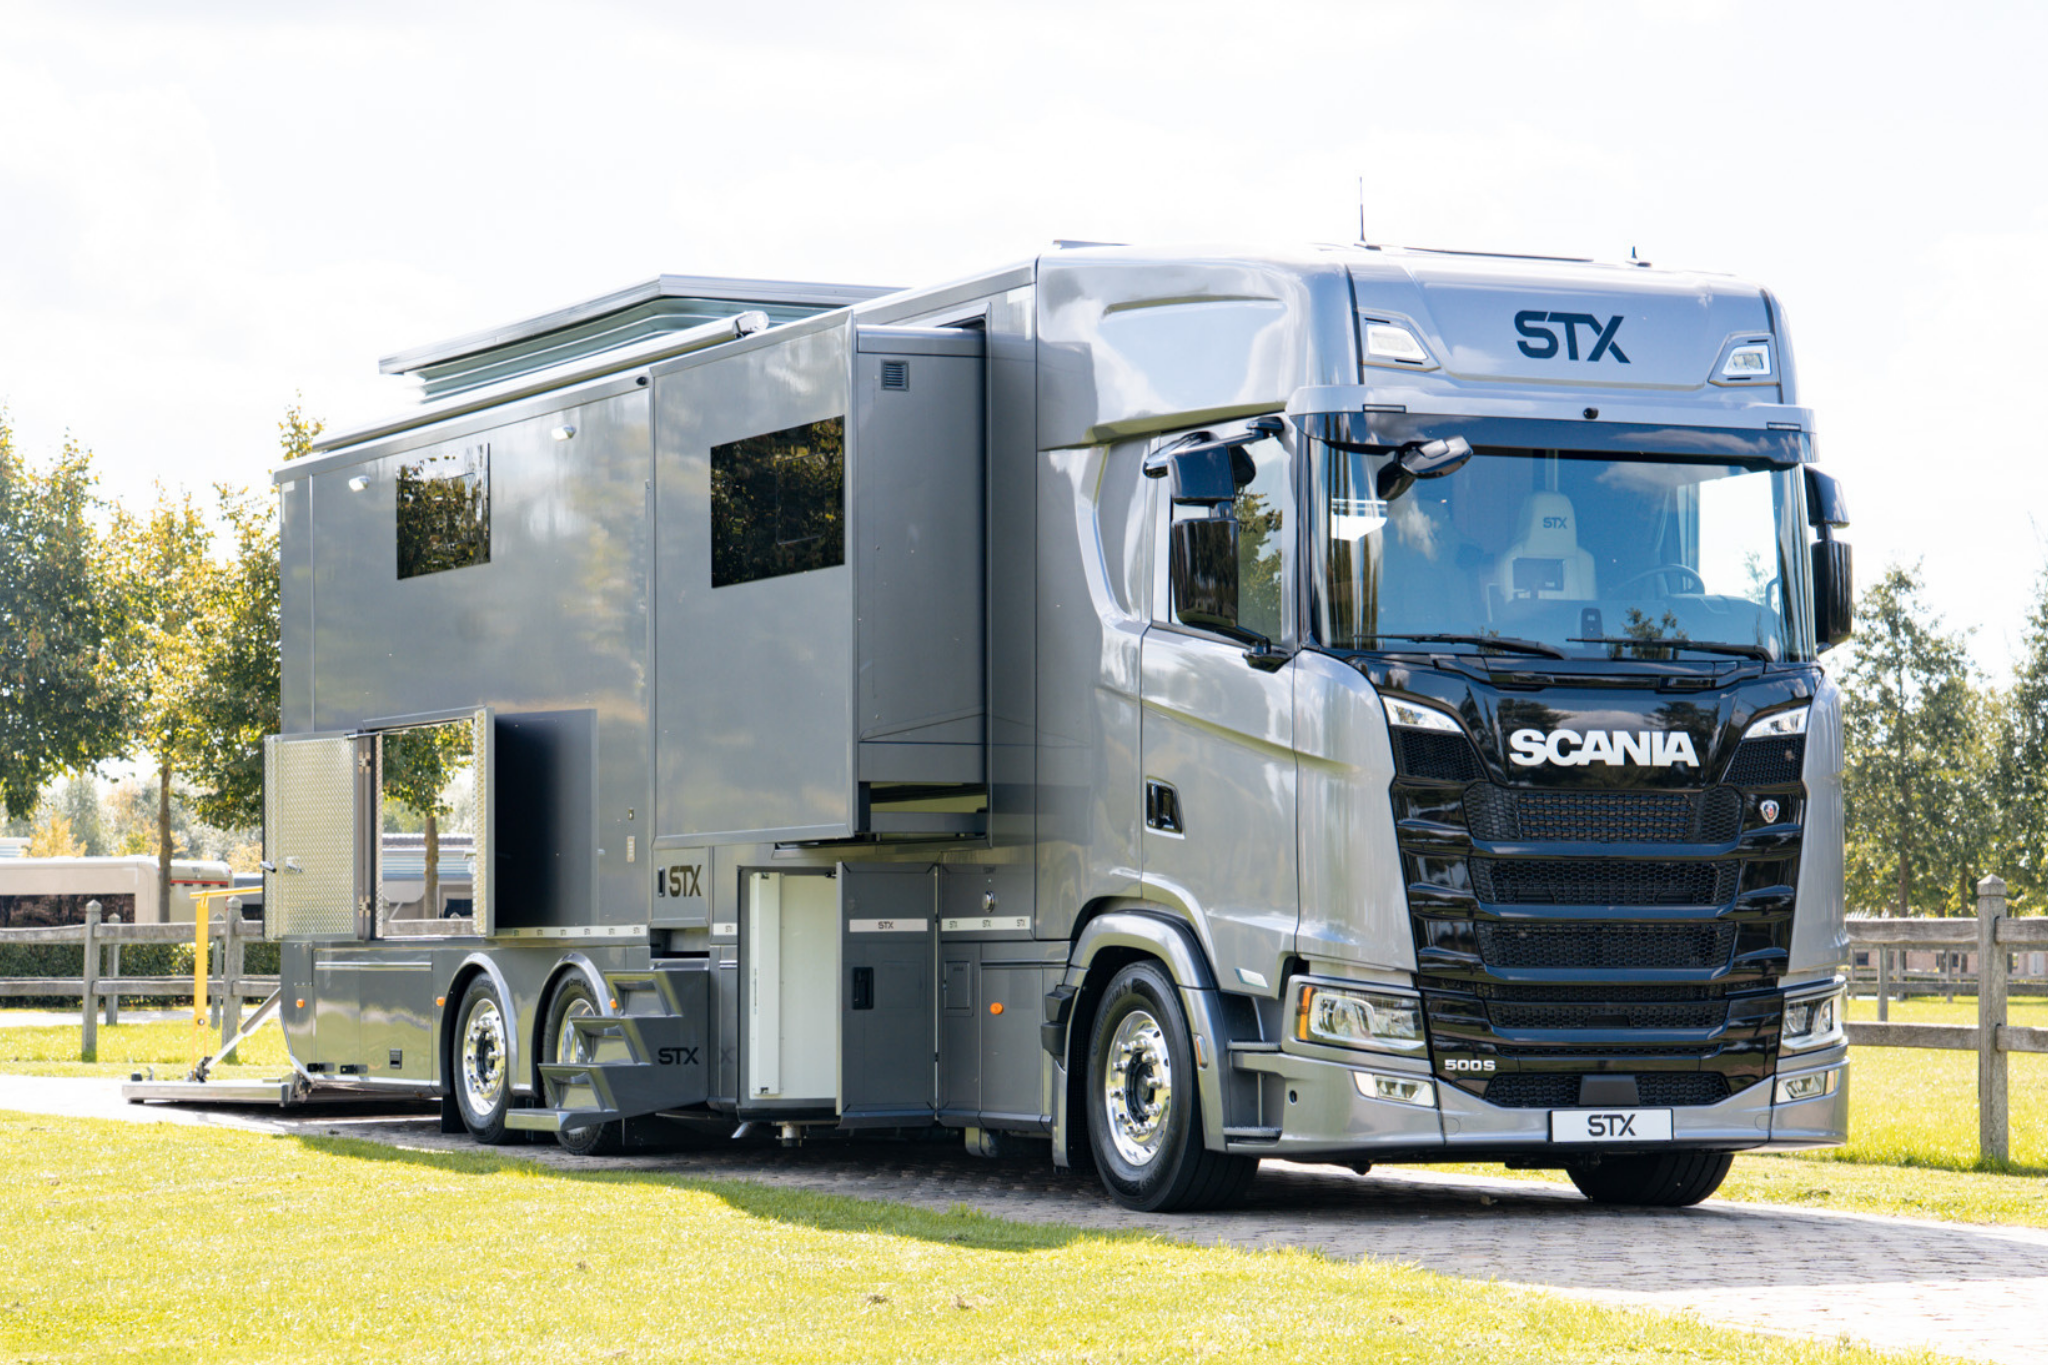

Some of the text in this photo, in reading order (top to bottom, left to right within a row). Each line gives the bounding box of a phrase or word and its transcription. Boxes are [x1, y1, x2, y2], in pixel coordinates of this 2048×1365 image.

[1513, 309, 1631, 364] STX
[1542, 516, 1568, 530] STX
[1509, 728, 1700, 767] SCANIA
[669, 864, 702, 898] STX
[877, 920, 894, 930] STX
[657, 1046, 699, 1066] STX
[1444, 1059, 1496, 1072] 500S
[1587, 1113, 1636, 1137] STX
